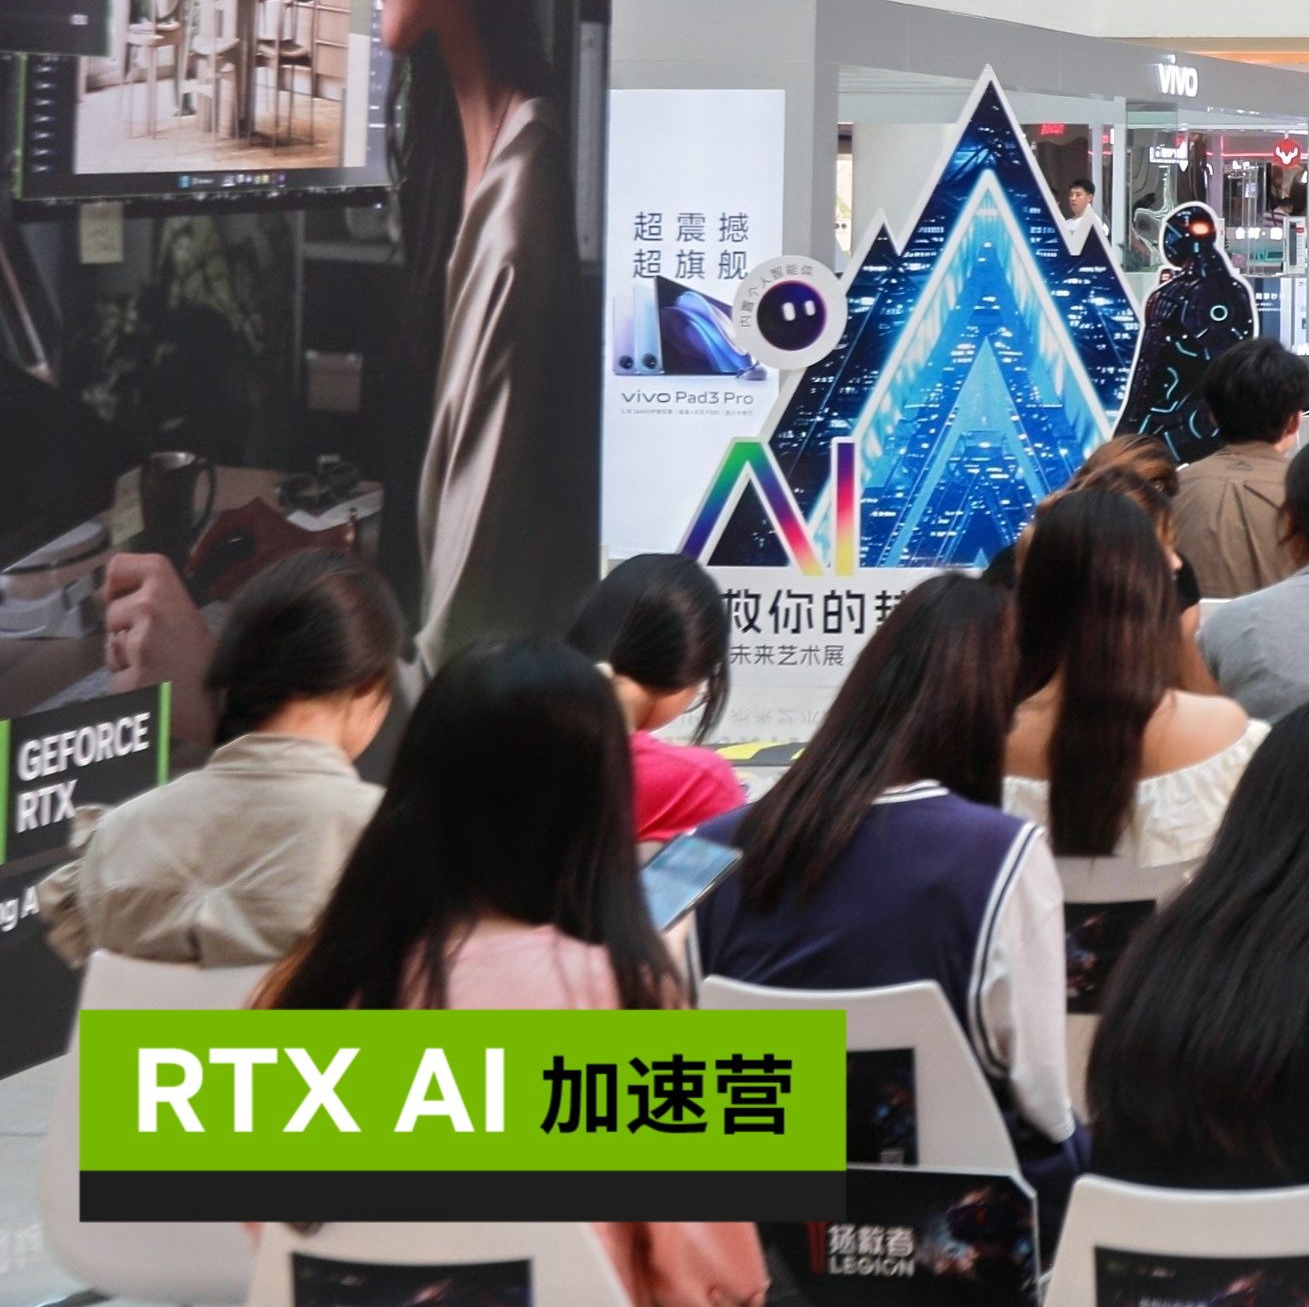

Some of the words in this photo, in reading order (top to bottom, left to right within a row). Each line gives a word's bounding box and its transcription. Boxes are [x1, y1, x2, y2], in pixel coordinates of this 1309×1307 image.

[1158, 54, 1199, 97] vivo
[633, 212, 749, 243] 超震撼
[632, 250, 749, 280] 超旗舰
[621, 390, 671, 404] vivo
[675, 390, 720, 405] Pad3
[723, 391, 754, 405] Pro
[679, 437, 854, 577] AI
[730, 644, 845, 667] 未来艺术展
[17, 712, 152, 782] GEFORCE
[16, 779, 78, 834] RTX
